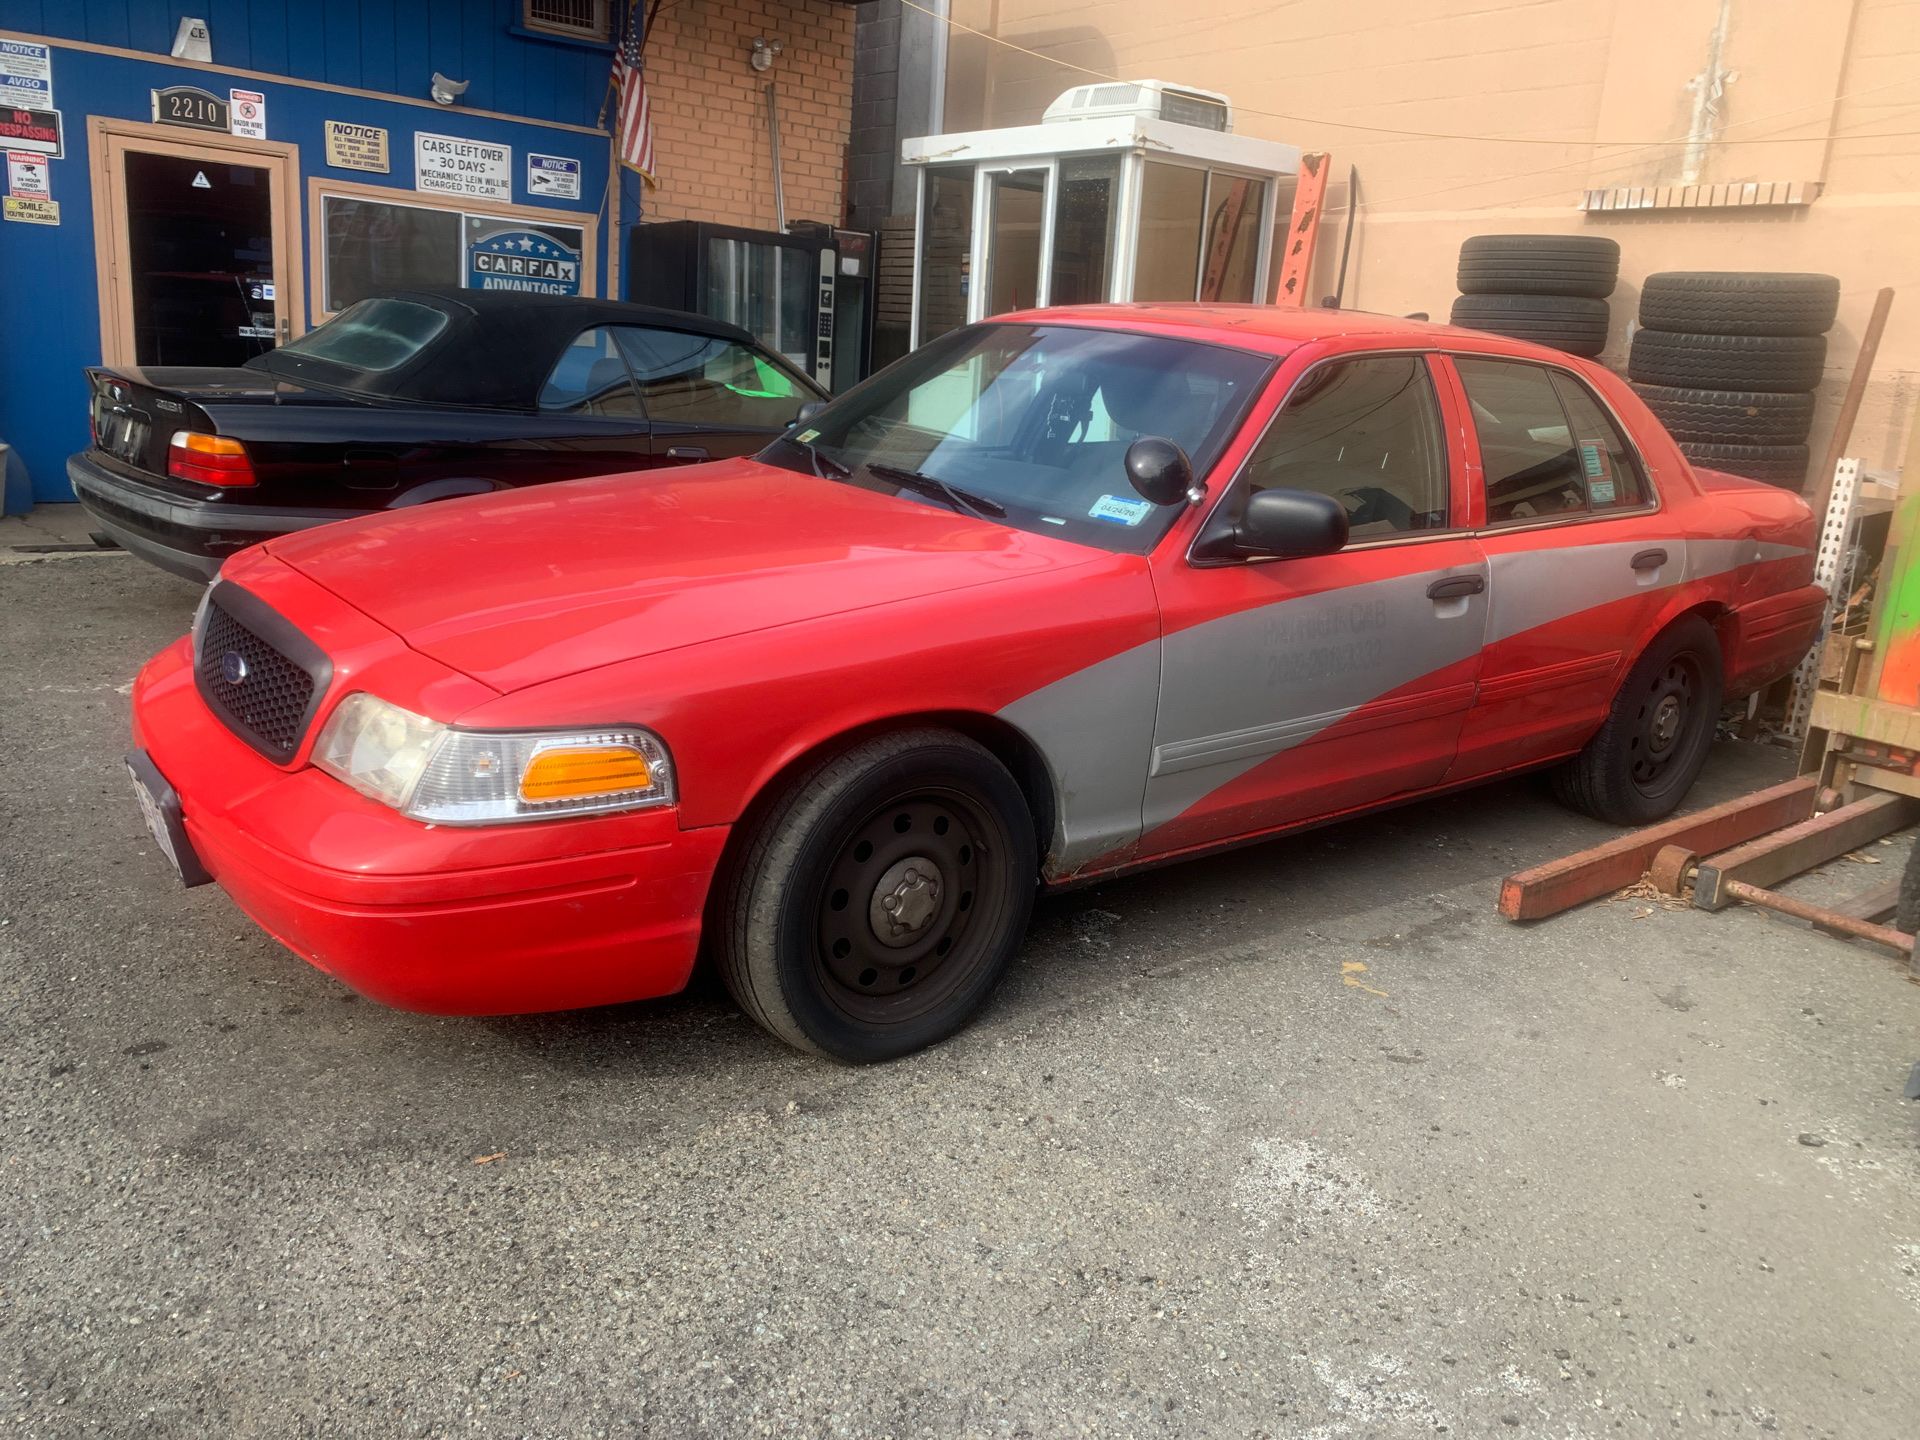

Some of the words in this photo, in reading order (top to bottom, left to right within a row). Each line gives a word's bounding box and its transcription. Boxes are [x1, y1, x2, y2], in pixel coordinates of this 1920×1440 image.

[2, 43, 41, 56] NOTICE
[8, 76, 40, 88] AVISO
[170, 96, 216, 122] 2210
[14, 111, 32, 124] NO
[0, 122, 56, 142] RESPASSING
[241, 128, 256, 136] FENCE
[333, 124, 381, 139] NOTICE
[422, 140, 452, 154] CARS
[455, 144, 478, 158] LEFT
[481, 148, 503, 161] OVER
[9, 153, 45, 163] WARNING
[440, 157, 455, 168] 30
[458, 160, 486, 173] DAYS
[542, 160, 567, 170] NOTICE
[424, 179, 462, 191] CHARGED
[465, 184, 476, 192] TO
[479, 187, 496, 195] CAR
[466, 176, 483, 184] LEIN
[485, 178, 500, 187] WILL
[501, 180, 509, 188] BE
[478, 256, 572, 280] CARFAX
